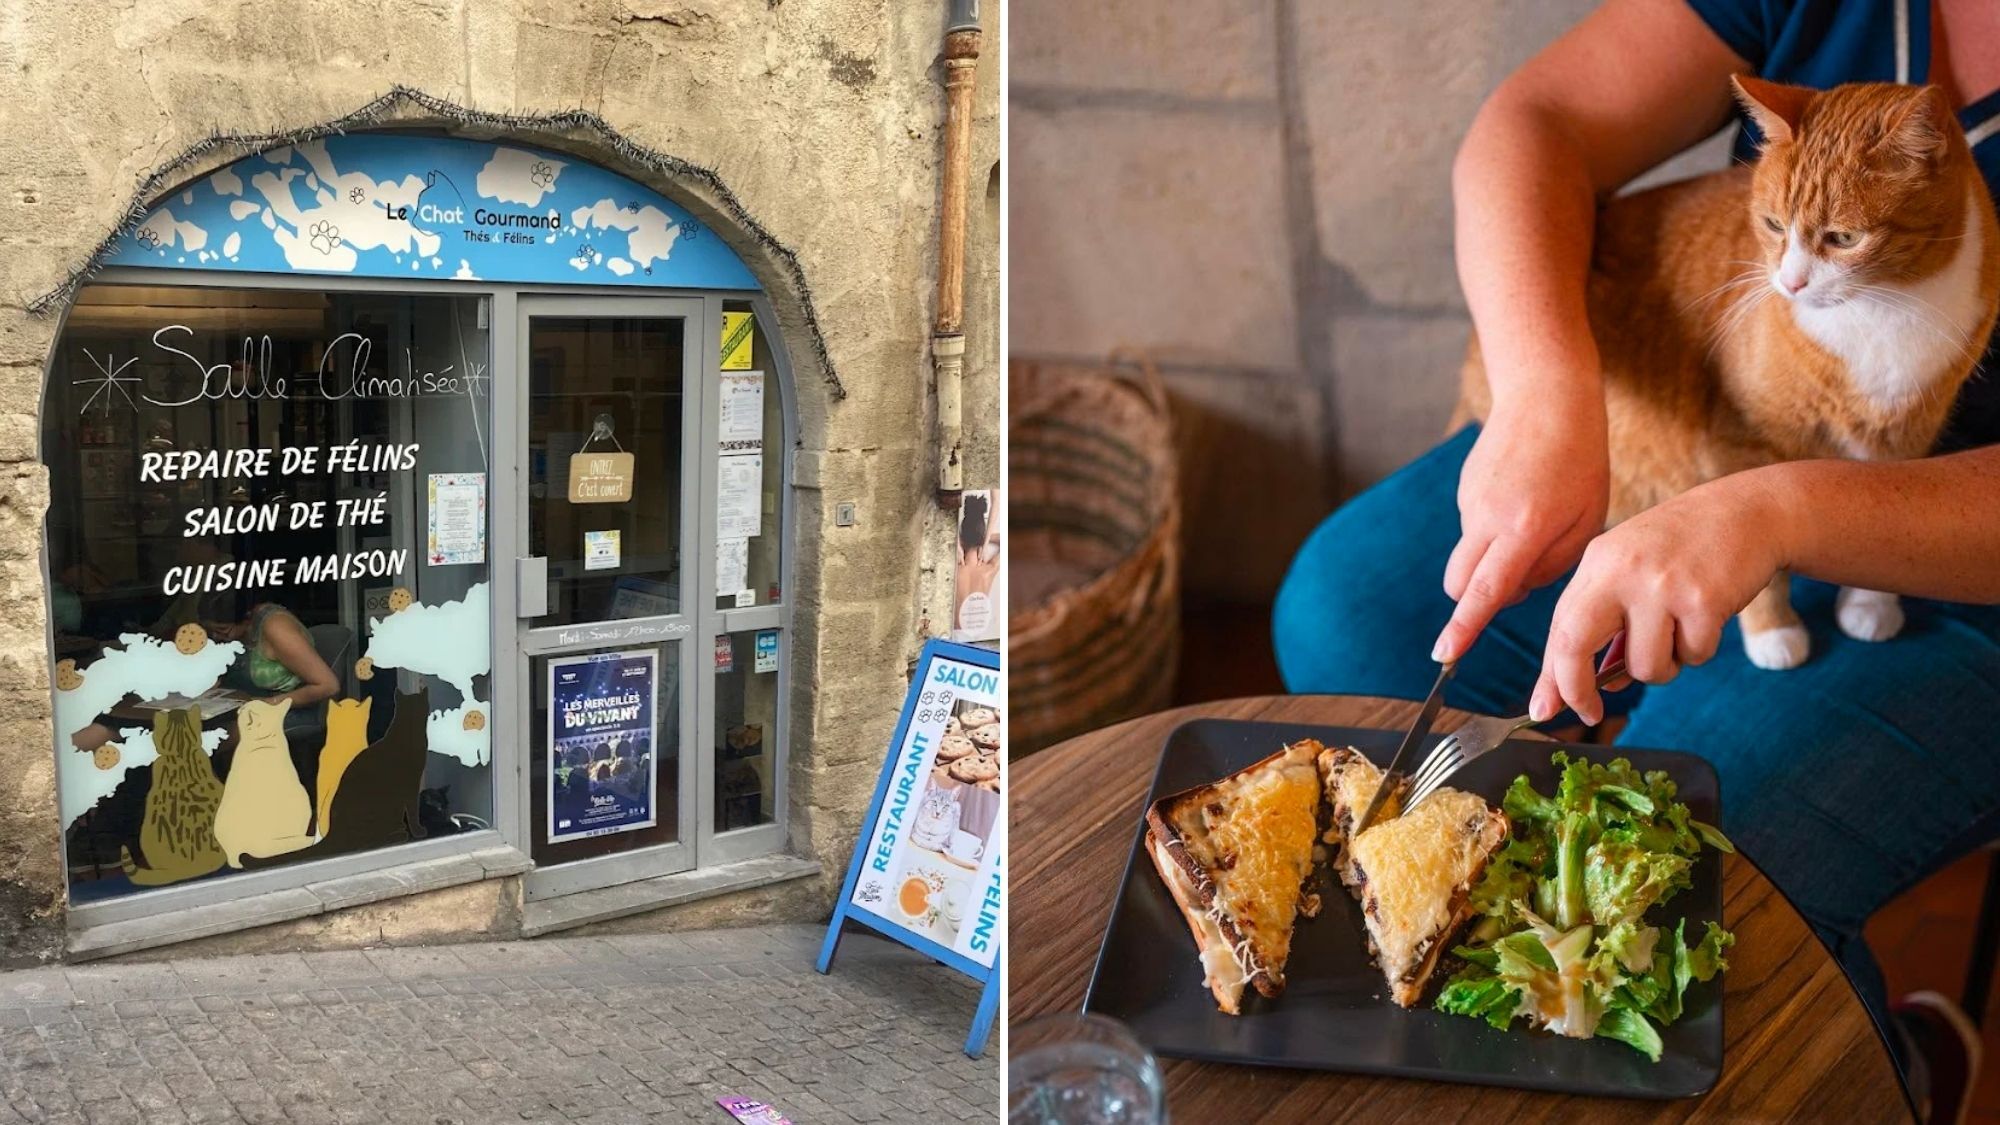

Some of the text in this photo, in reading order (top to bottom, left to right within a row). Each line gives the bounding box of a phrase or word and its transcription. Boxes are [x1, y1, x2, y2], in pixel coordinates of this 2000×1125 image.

[387, 203, 561, 230] Le Chat Gourmand
[463, 230, 490, 243] Thés
[503, 231, 535, 245] Félins
[142, 325, 467, 407] Salle Climatisée
[140, 438, 420, 483] REPAIRE DE FÉLINS
[578, 480, 623, 498] C'est ouvert
[183, 491, 388, 538] SALON DE THÉ
[162, 549, 407, 596] CUISINE MAISON
[934, 664, 998, 695] SALON
[563, 694, 640, 711] LES MERVEILLES
[564, 706, 640, 728] DU VIVANT
[872, 731, 929, 873] RESTAURANT
